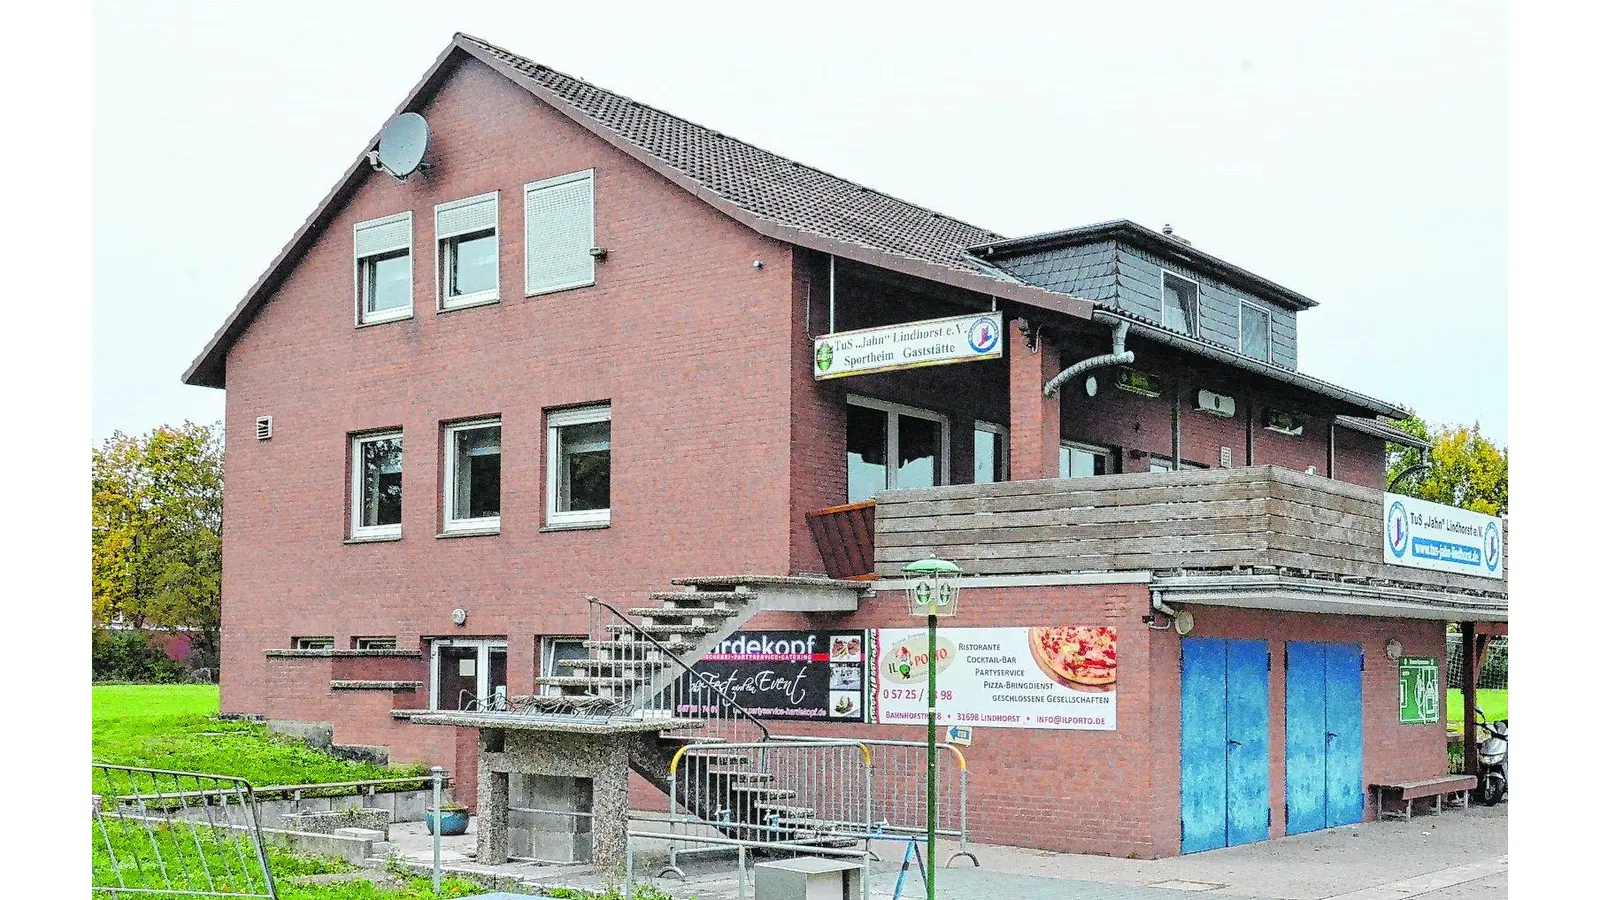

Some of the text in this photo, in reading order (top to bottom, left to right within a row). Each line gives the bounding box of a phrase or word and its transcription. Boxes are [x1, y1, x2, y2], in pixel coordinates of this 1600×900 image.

[834, 340, 853, 352] TuS
[893, 326, 943, 344] Lindhorst
[946, 322, 967, 336] e.V.
[844, 351, 895, 368] Sportheim
[902, 342, 956, 359] Gaststätte
[1410, 512, 1423, 526] TuS
[1446, 519, 1473, 536] Lindhorst
[958, 642, 1001, 652] RISTORANTE
[888, 648, 948, 674] IL POTO
[966, 655, 1017, 664] COCKTAIL-BAR
[975, 668, 1025, 677] PARTYSERVICE
[755, 666, 807, 705] Event
[983, 681, 1054, 690] PIZZA-BRINGDIENST
[891, 689, 903, 699] 57
[905, 689, 917, 699] 25
[940, 690, 953, 700] 98
[992, 694, 1109, 704] GESCHLOSSENE GESELLSCHAFTEN
[956, 713, 979, 721] 31698
[980, 714, 1020, 723] LINDHORST
